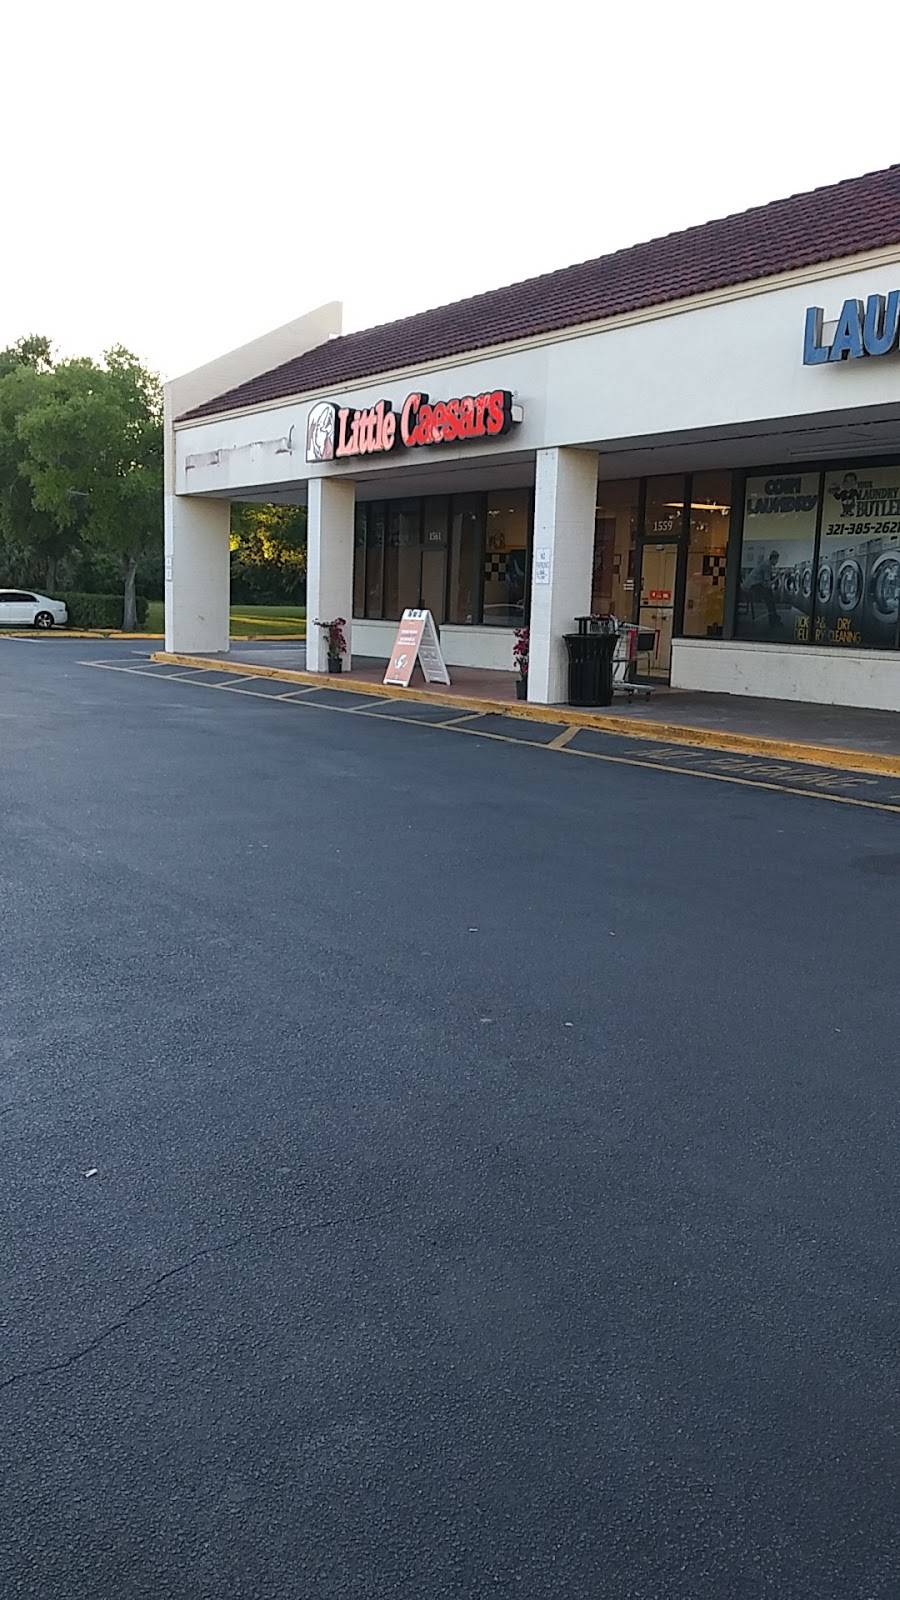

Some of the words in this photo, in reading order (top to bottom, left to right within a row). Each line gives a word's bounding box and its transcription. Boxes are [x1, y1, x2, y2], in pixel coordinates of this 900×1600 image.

[336, 399, 397, 457] Little
[401, 390, 505, 447] Caesars
[653, 520, 673, 532] 1559
[837, 617, 854, 631] DRY
[830, 631, 862, 645] CLEANING
